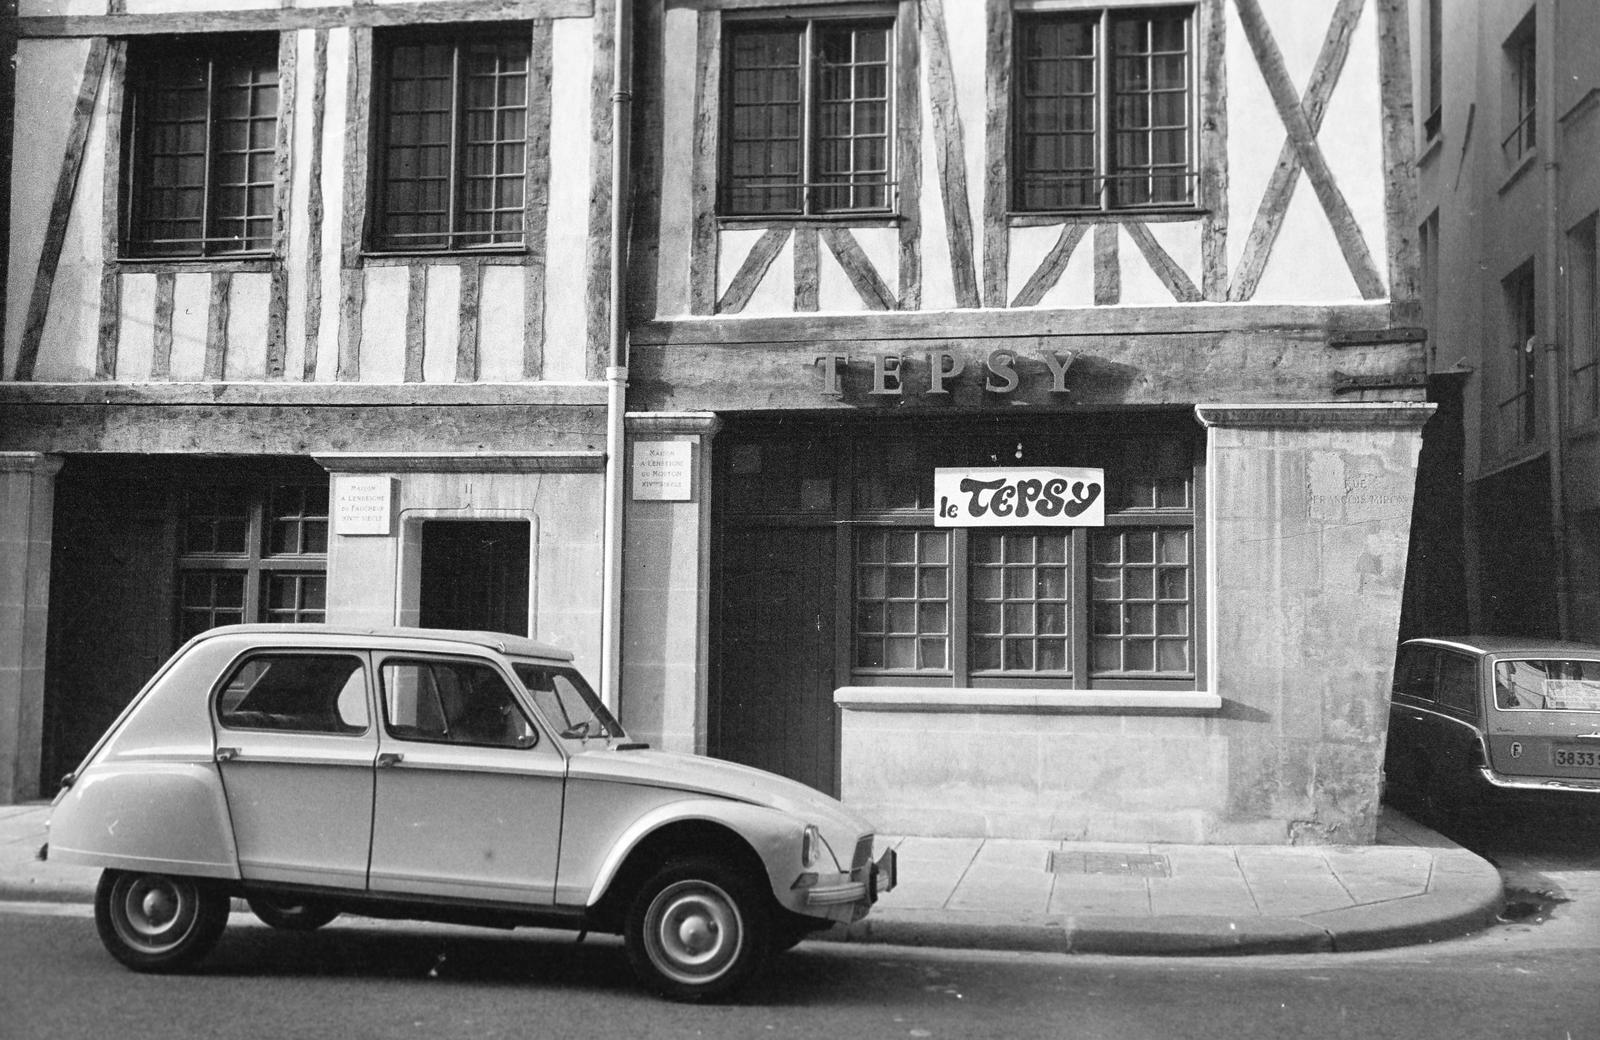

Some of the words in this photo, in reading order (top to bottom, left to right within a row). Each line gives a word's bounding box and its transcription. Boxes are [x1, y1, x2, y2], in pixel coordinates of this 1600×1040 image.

[814, 349, 1080, 395] TEPSY
[939, 496, 958, 518] le
[1513, 744, 1520, 756] F
[1557, 751, 1594, 766] 3833
